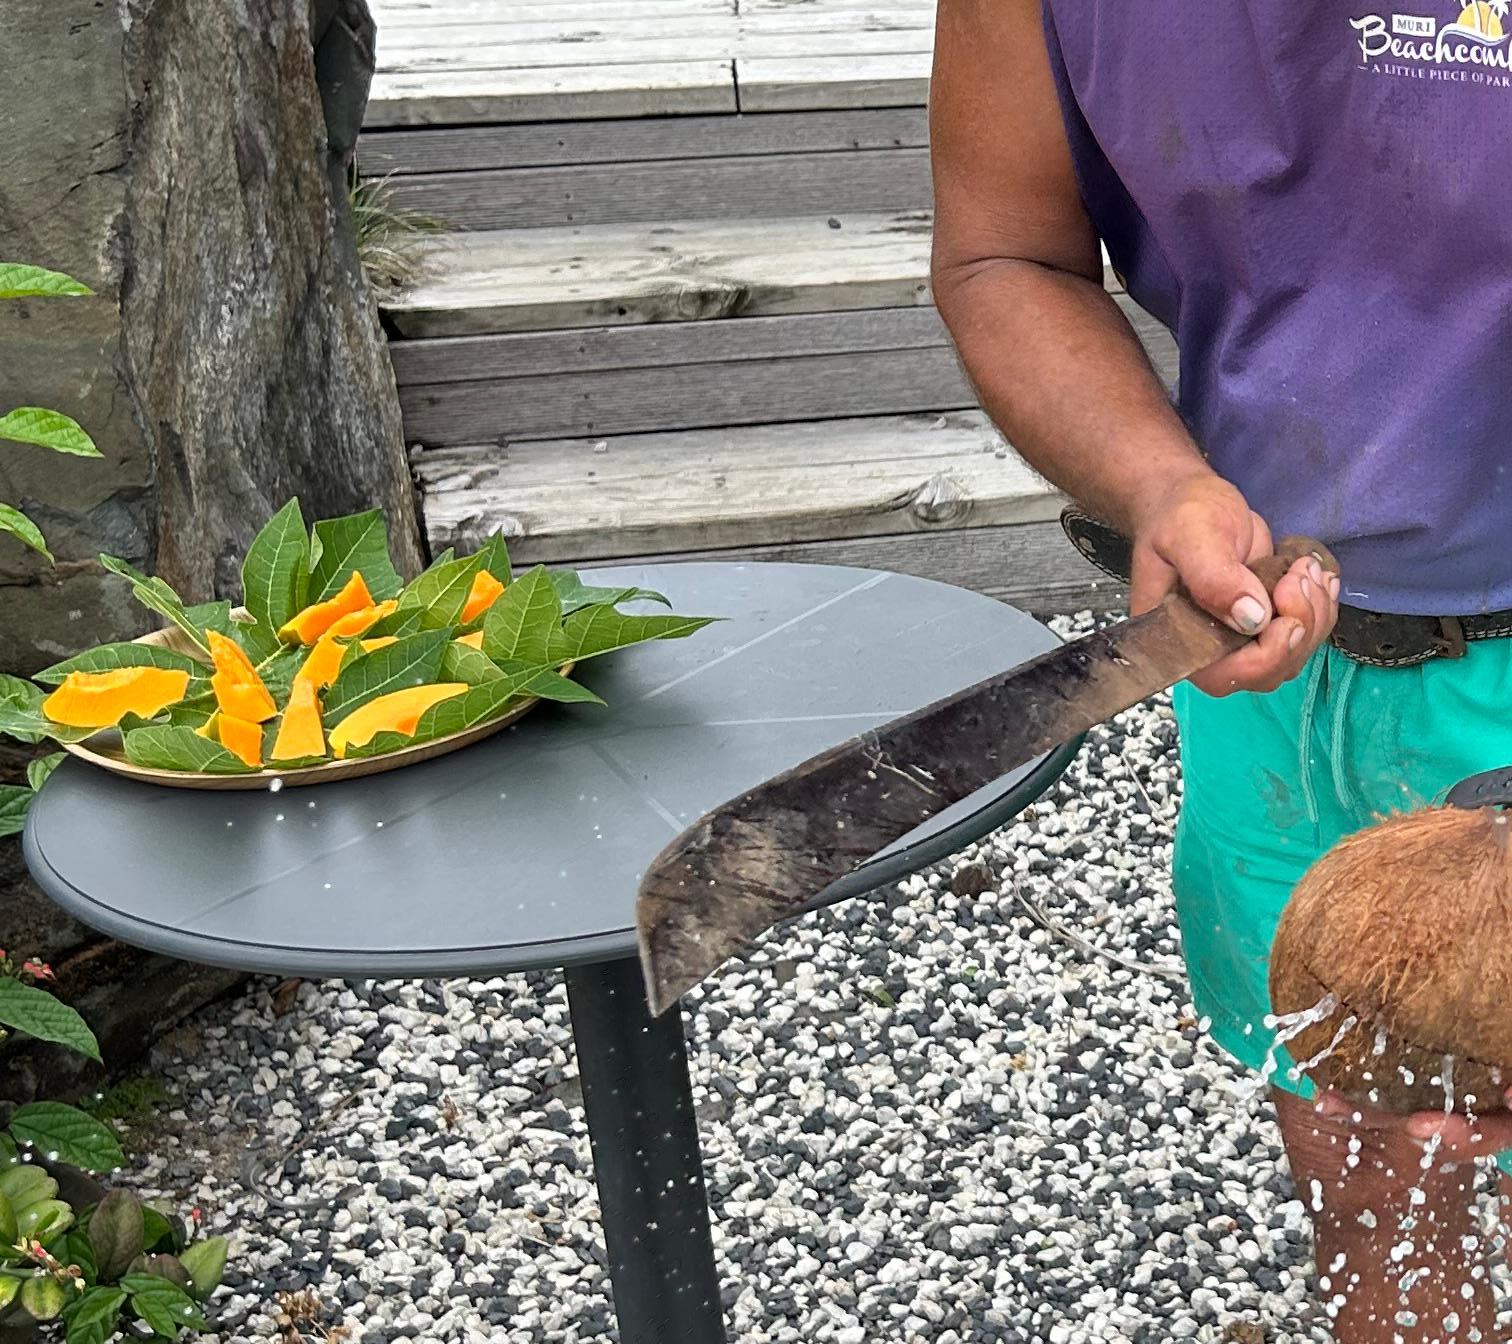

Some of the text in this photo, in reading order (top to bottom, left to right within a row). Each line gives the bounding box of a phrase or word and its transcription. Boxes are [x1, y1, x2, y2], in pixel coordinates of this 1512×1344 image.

[1397, 19, 1431, 32] MURI
[1372, 63, 1381, 73] A
[1384, 63, 1425, 79] LITTLE
[1429, 68, 1468, 82] PIECE
